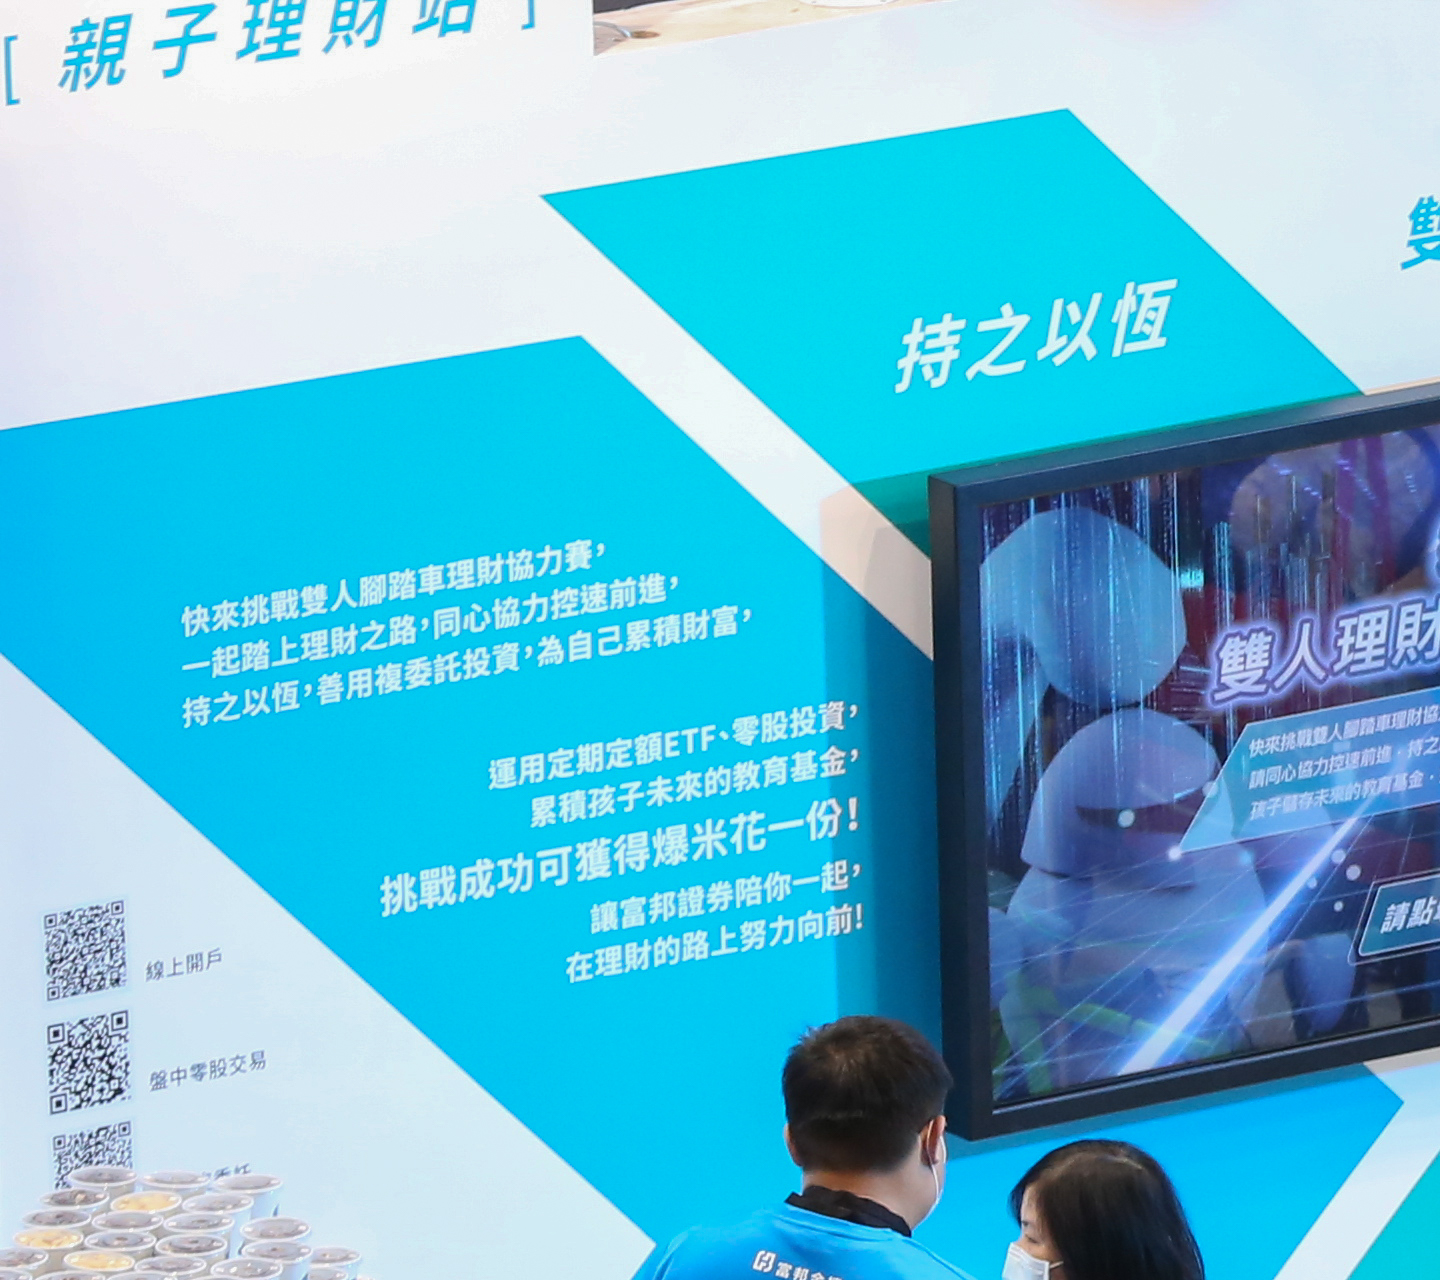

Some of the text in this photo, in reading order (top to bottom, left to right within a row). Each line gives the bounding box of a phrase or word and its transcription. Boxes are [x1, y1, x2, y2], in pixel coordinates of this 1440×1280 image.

[893, 278, 1178, 394] 持之以恆
[380, 797, 862, 918] 挑戰成功可獲得爆米花一份!
[145, 948, 223, 982] 線上開戶
[566, 902, 865, 985] 在理財的路上努力向前!
[149, 1050, 268, 1093] 盤中零股交易
